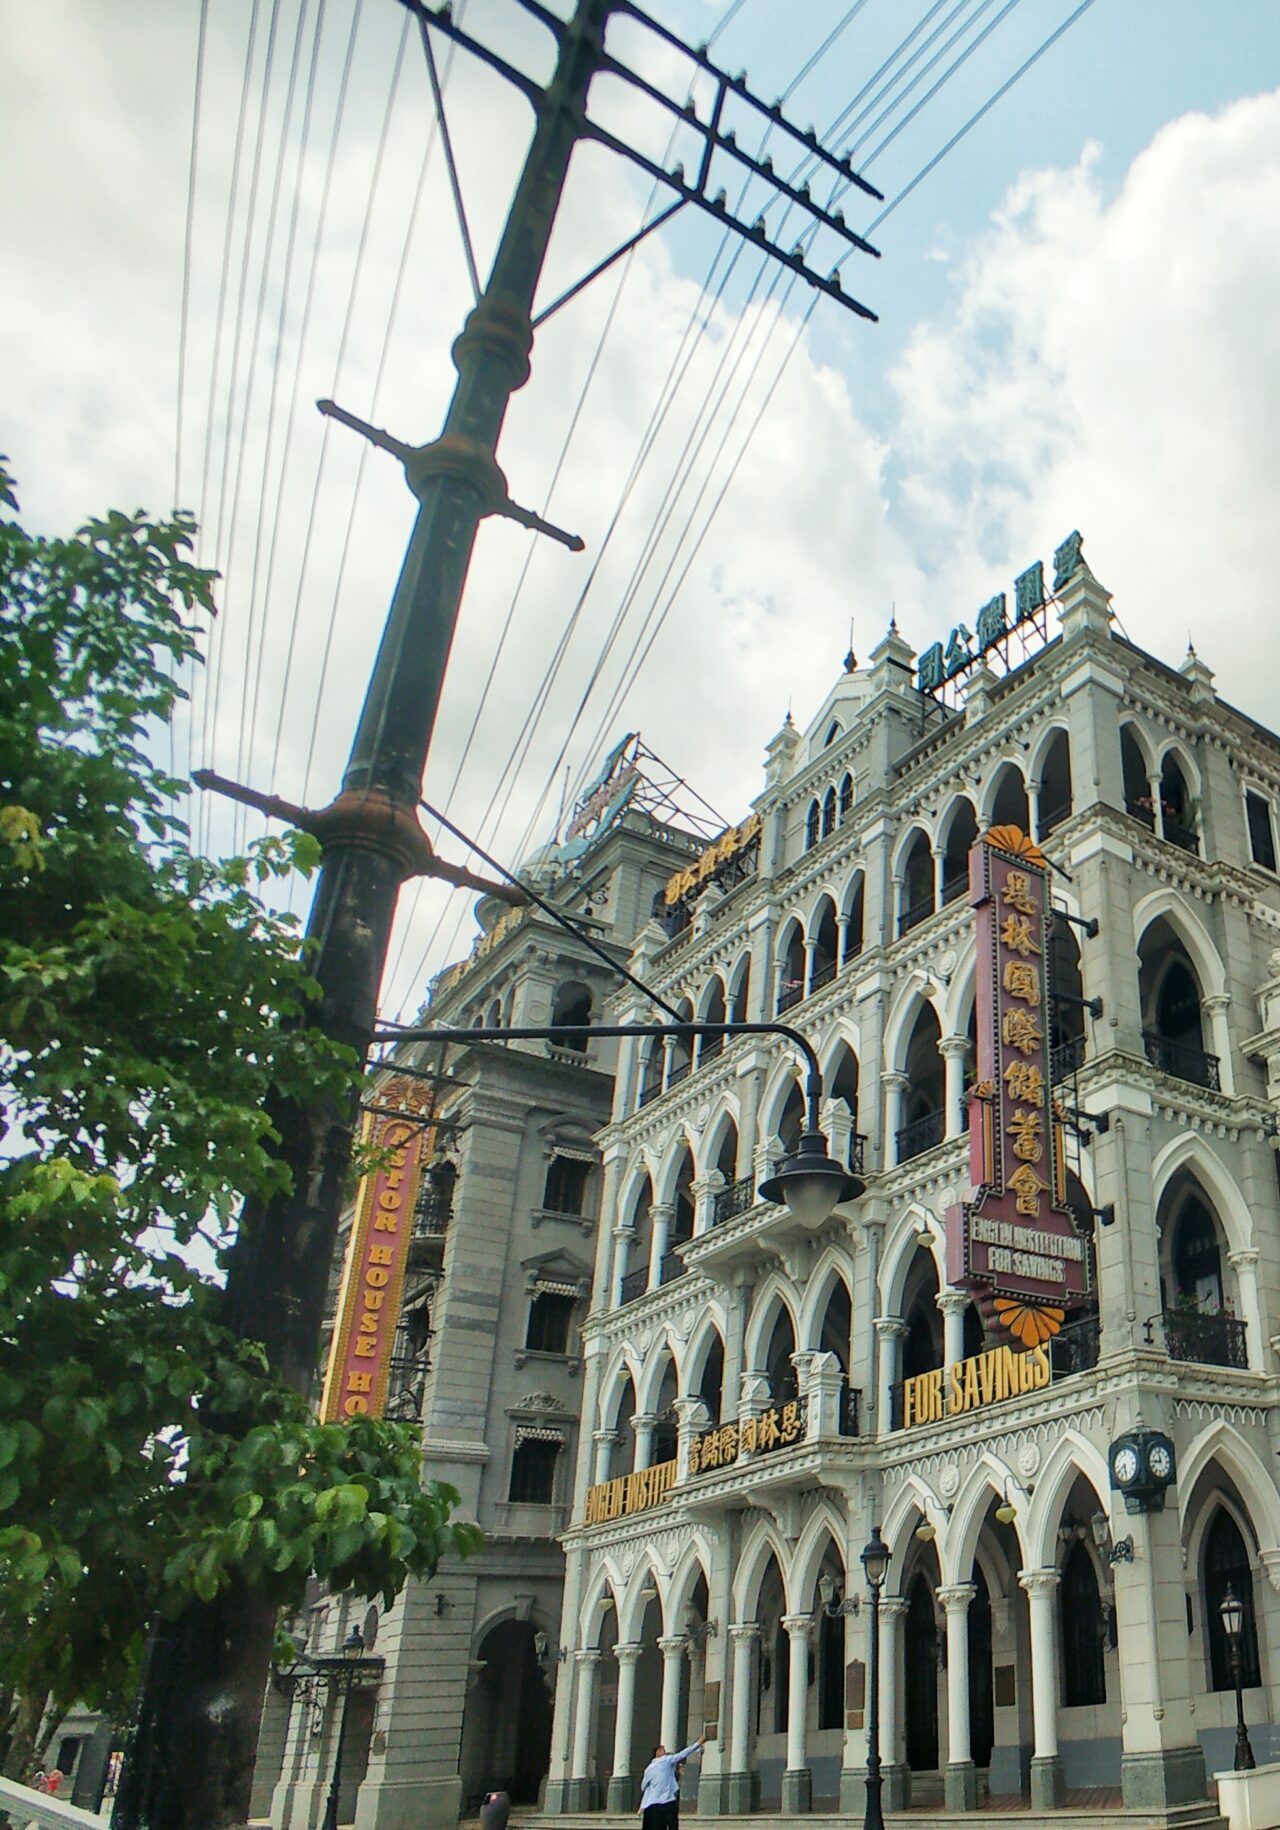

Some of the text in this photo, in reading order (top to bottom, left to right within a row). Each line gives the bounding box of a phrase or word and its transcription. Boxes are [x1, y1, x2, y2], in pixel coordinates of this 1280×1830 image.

[374, 1127, 413, 1233] ASTOR
[354, 1244, 393, 1358] HOUSE
[988, 1245, 1066, 1283] FOR SAVINGS
[903, 1341, 1050, 1429] FOR SAVINGS
